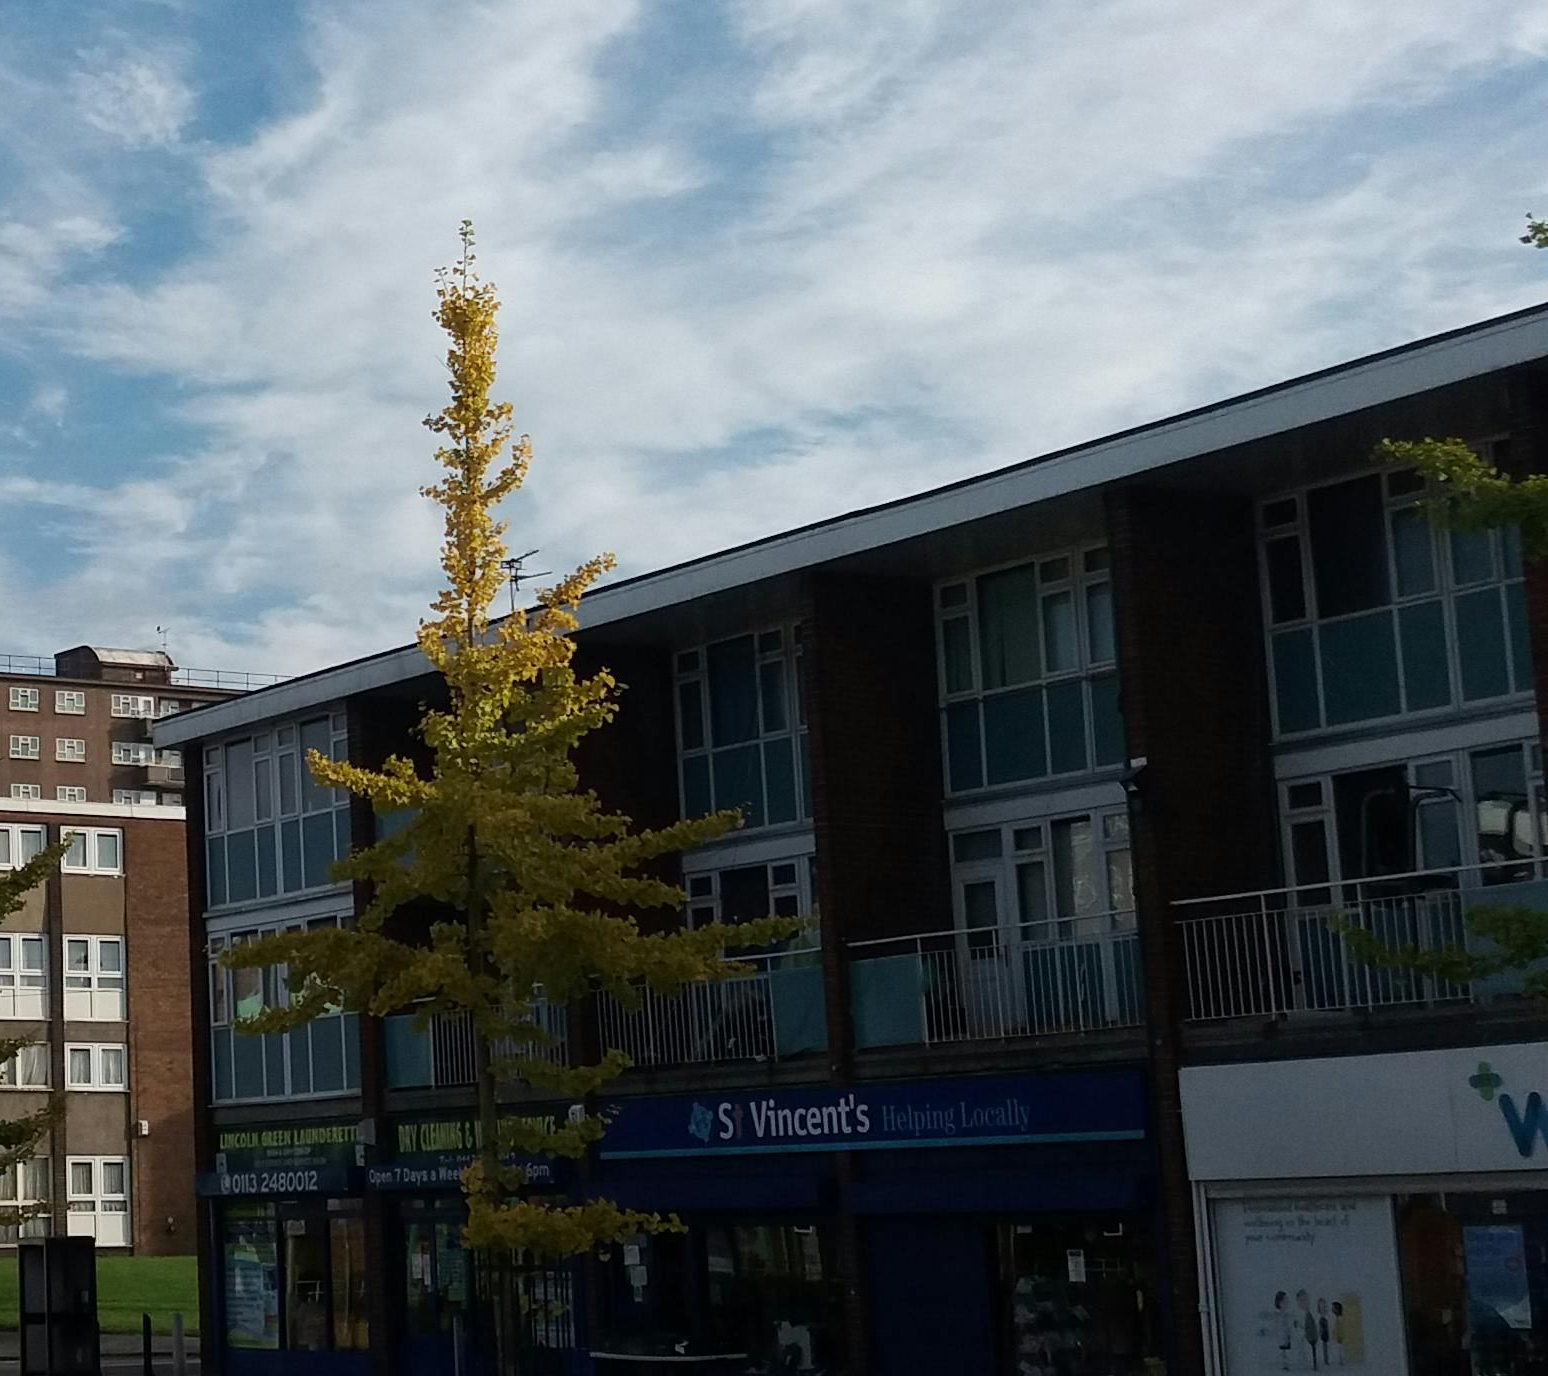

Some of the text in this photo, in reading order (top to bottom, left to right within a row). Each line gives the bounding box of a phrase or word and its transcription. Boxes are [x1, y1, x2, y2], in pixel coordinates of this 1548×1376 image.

[749, 1093, 870, 1138] Vincent's
[882, 1104, 955, 1138] Helping
[961, 1097, 1031, 1132] Locally
[219, 1125, 358, 1150] LINCOLN GREEN LAUNDERETT
[397, 1124, 417, 1153] DRY
[420, 1122, 462, 1151] CLEANING
[232, 1170, 318, 1194] 0113 2480012
[369, 1170, 392, 1186] Open
[394, 1168, 402, 1182] 7
[403, 1166, 428, 1186] Days
[429, 1171, 438, 1182] a
[525, 1162, 550, 1181] 6pm
